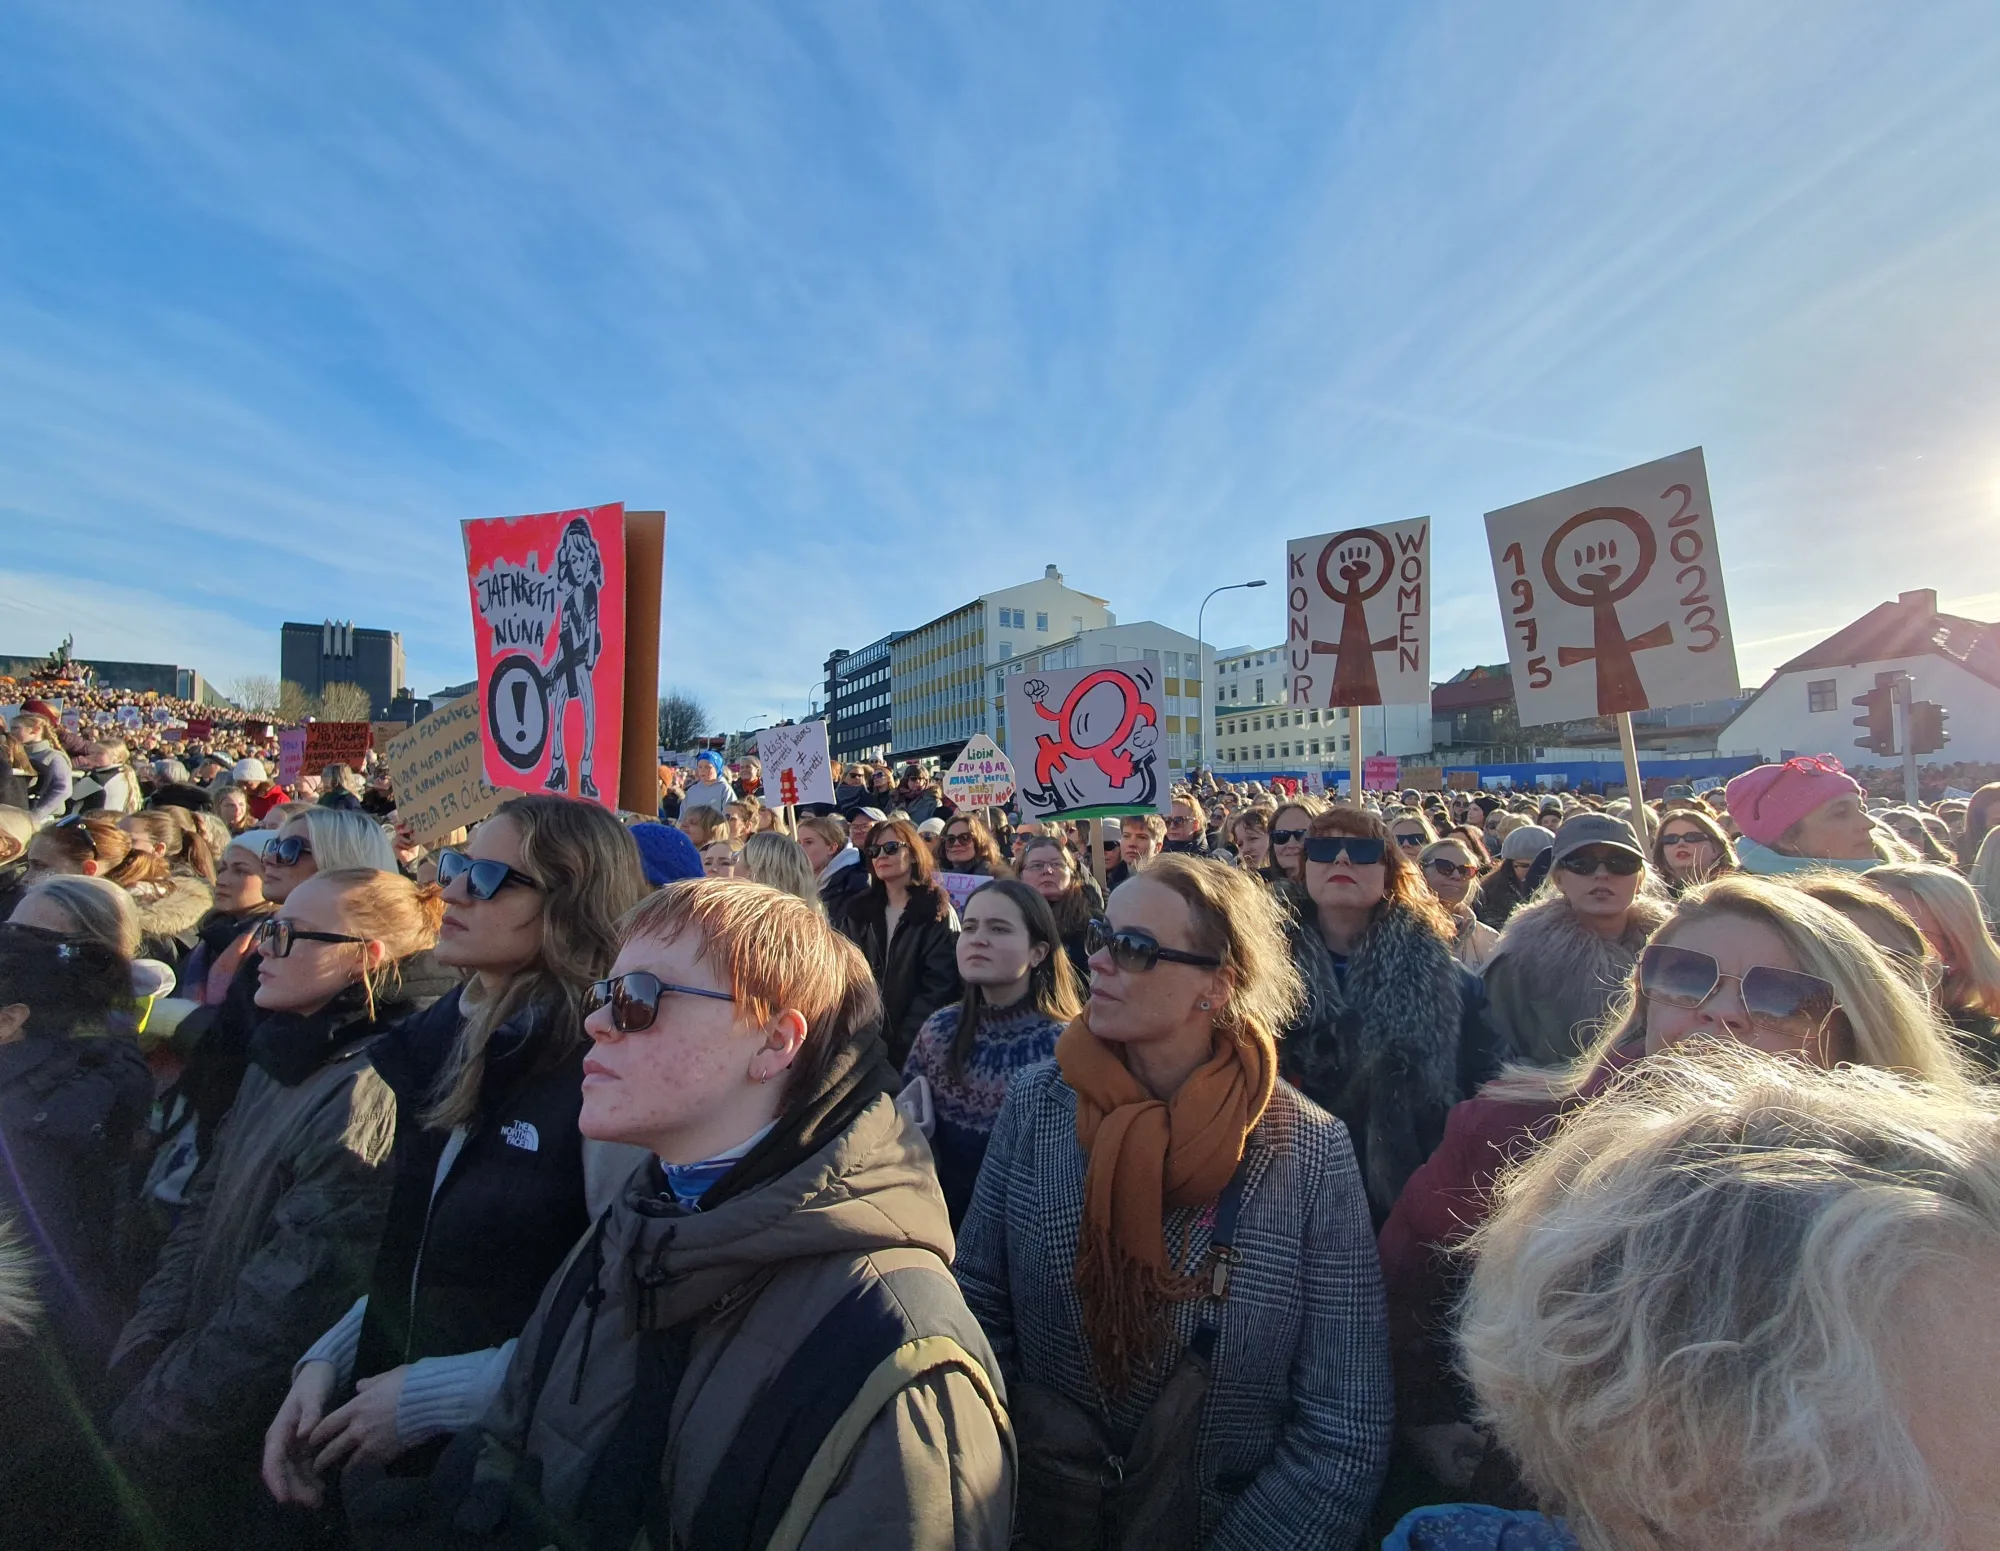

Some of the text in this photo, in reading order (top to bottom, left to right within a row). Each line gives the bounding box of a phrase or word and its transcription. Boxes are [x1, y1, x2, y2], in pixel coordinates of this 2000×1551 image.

[1659, 483, 1721, 653] 2023
[477, 562, 555, 614] JAFNRÉTTI
[1394, 524, 1427, 673] WOMEN
[494, 612, 545, 648] NÚNA
[1289, 552, 1314, 705] KONUR
[1502, 541, 1553, 689] 1975
[790, 725, 812, 747] heims
[957, 763, 975, 773] ERU
[500, 1125, 527, 1141] NORTH
[506, 1135, 527, 1149] FACE
[513, 1119, 531, 1131] THE
